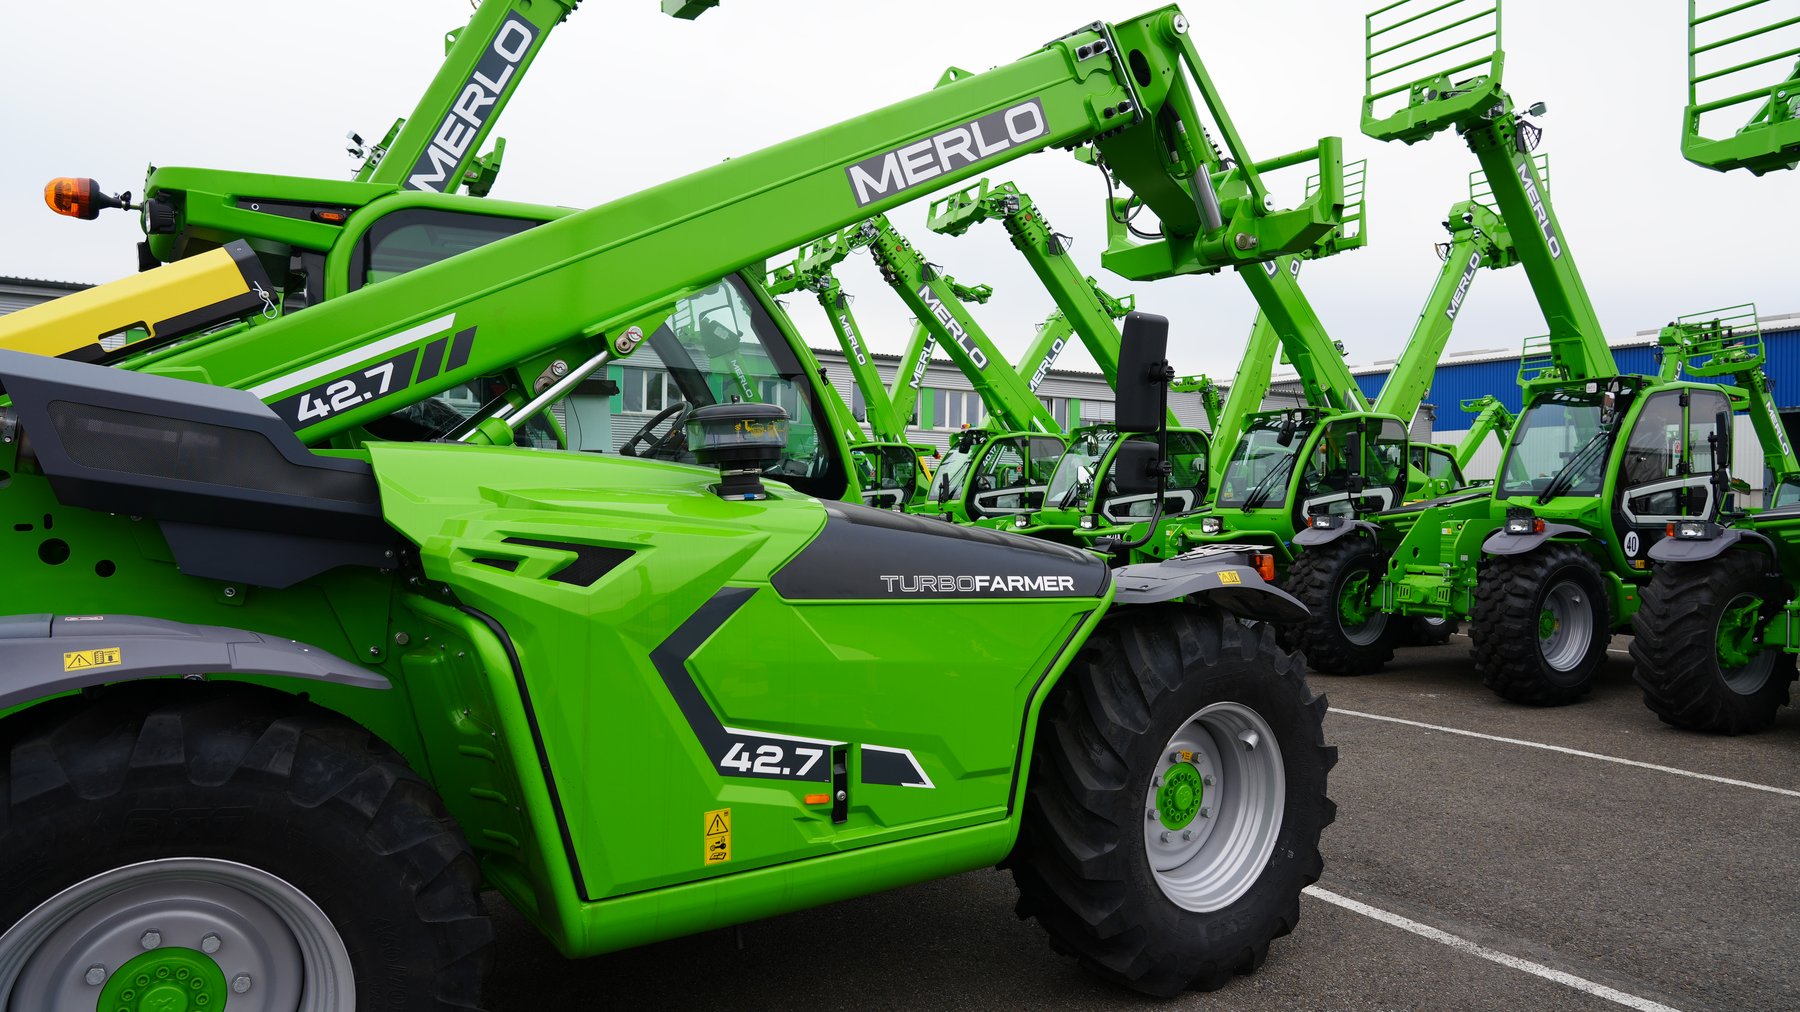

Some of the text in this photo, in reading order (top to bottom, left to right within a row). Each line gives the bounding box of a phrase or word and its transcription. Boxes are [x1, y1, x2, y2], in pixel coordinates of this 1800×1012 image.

[409, 19, 533, 192] MERLO
[849, 101, 1045, 204] MERLO
[1517, 162, 1561, 258] MERLO
[1446, 252, 1481, 319] MERLO
[839, 314, 866, 365] MERLO
[918, 286, 988, 370] MERLO
[297, 361, 394, 422] 42.7
[730, 359, 753, 398] MERLO
[1766, 401, 1789, 455] MERLO
[1626, 536, 1637, 552] 40
[880, 575, 1075, 593] TURBOFARMER
[720, 742, 824, 775] 42.7
